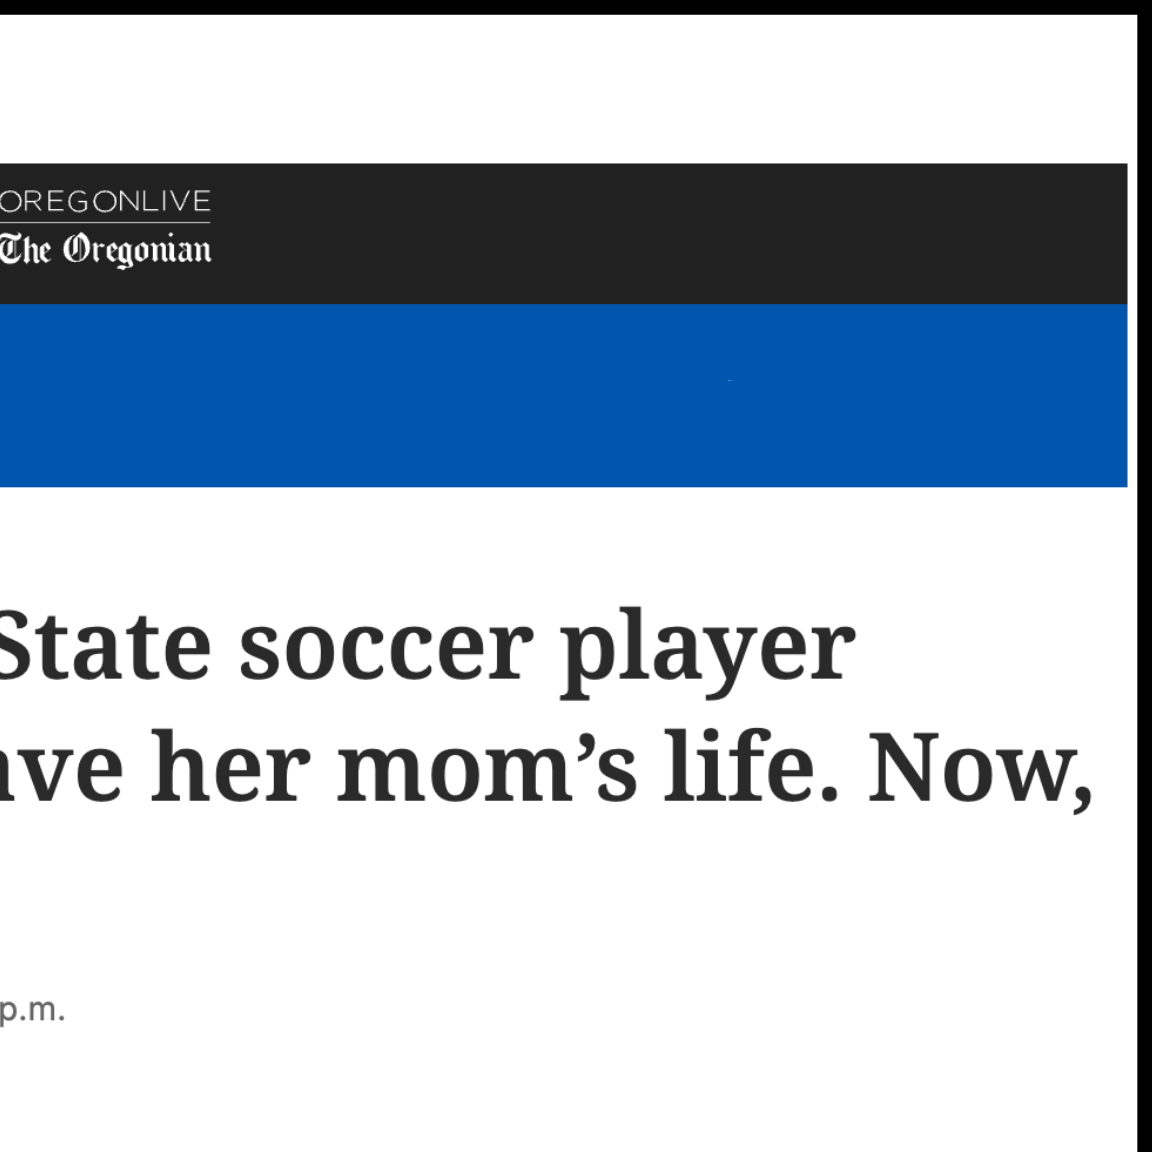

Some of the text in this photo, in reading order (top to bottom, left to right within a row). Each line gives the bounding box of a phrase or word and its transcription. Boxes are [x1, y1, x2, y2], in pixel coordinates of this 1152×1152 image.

[63, 232, 212, 270] Oregonian
[241, 626, 534, 680] soccer
[559, 606, 856, 701] player
[151, 728, 311, 802] her
[337, 732, 637, 802] mom’s
[664, 727, 838, 802] life.
[869, 732, 1091, 815] Now,
[0, 1001, 64, 1028] p.m.
